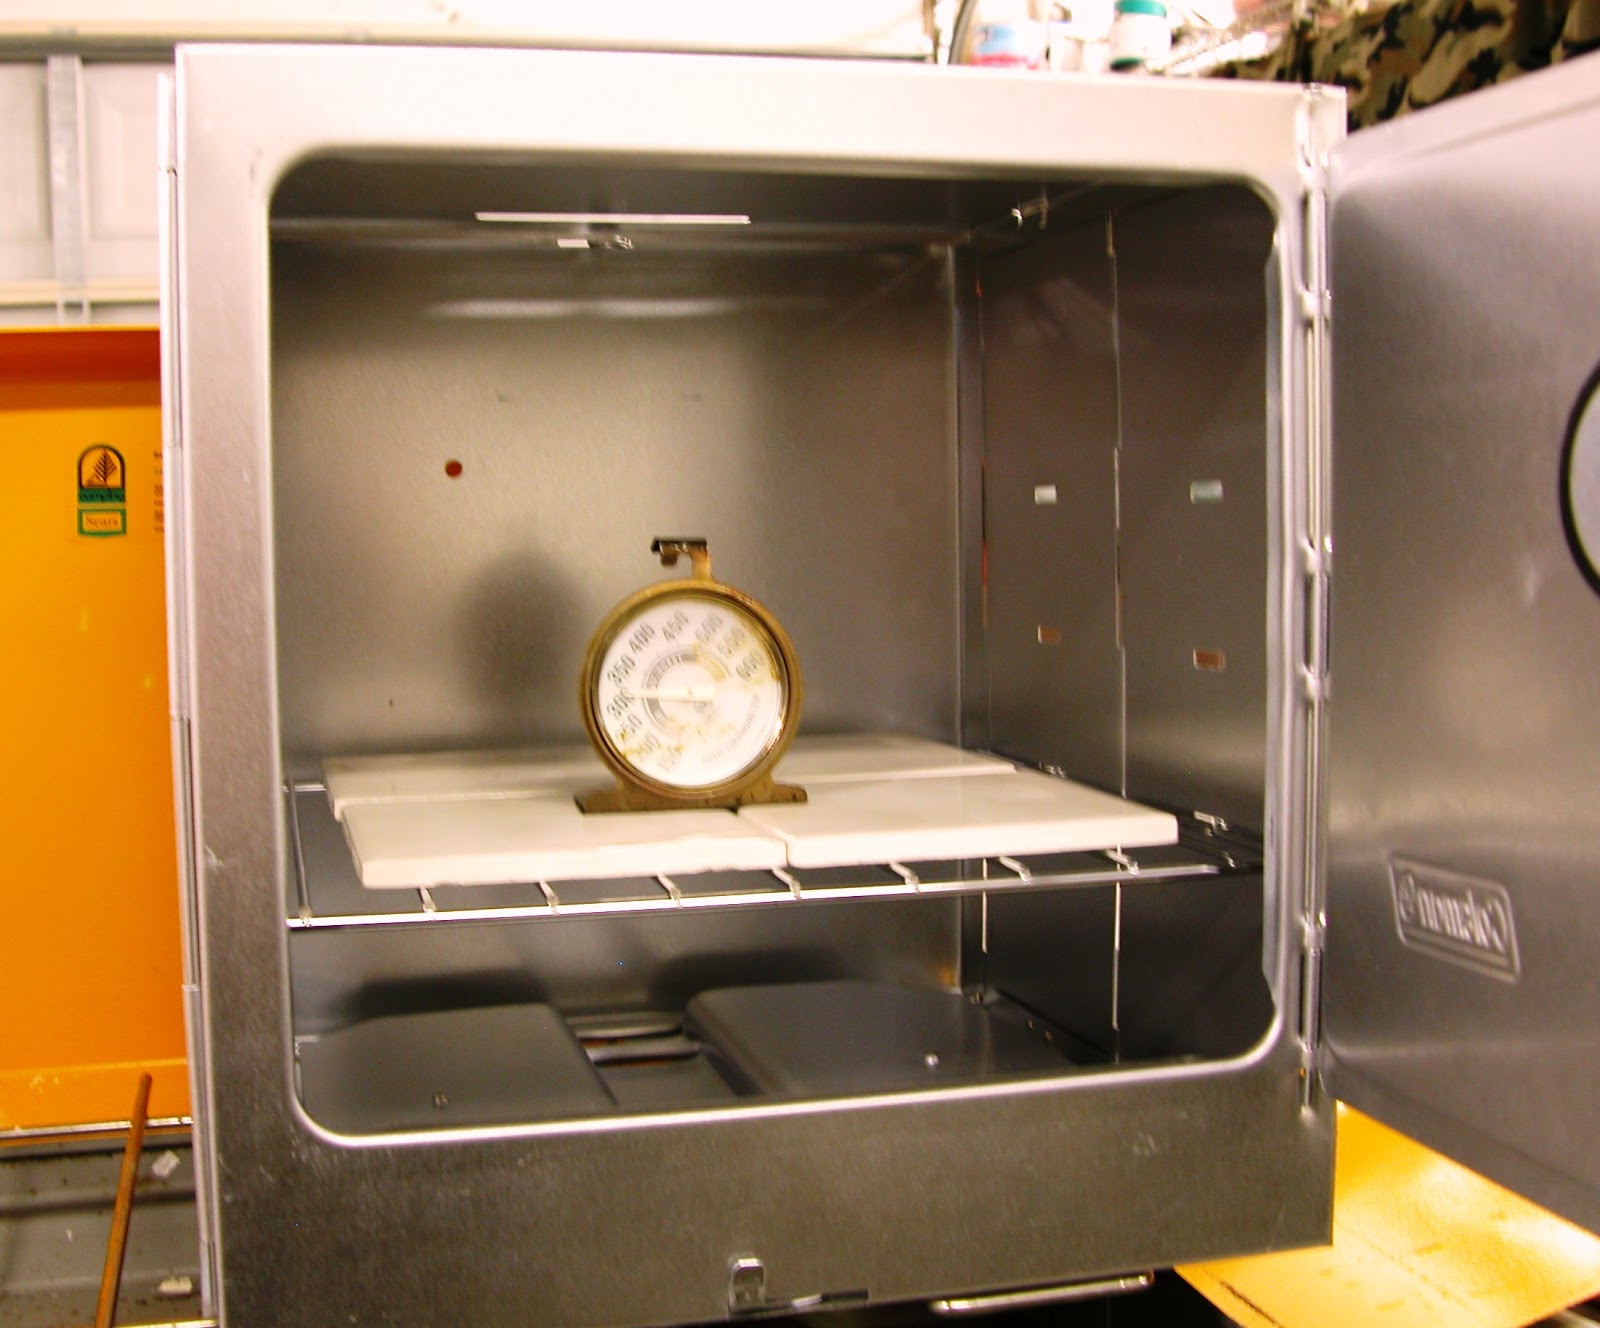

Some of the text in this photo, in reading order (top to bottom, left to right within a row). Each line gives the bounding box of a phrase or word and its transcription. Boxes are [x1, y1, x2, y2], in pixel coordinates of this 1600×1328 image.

[629, 622, 656, 653] 400
[662, 611, 689, 642] 450
[606, 653, 636, 686] 350
[735, 647, 766, 683] 600
